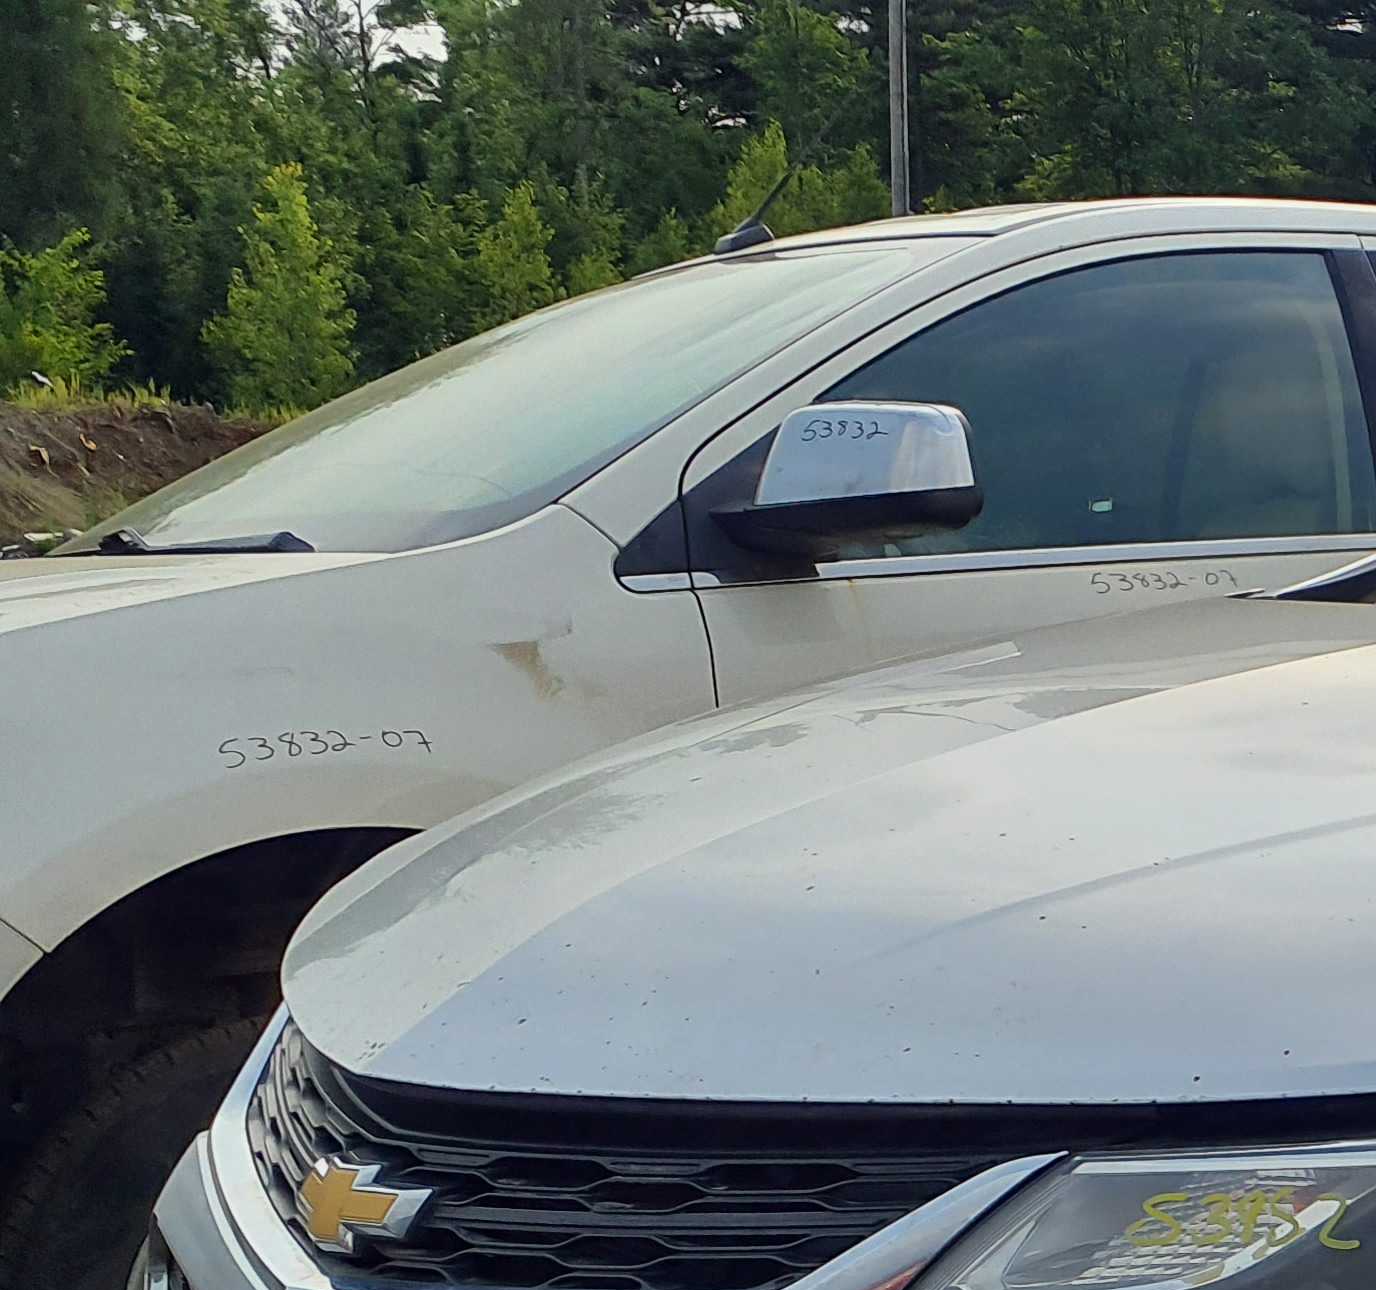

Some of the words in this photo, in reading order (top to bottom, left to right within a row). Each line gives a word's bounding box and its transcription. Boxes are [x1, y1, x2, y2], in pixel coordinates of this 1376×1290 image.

[801, 418, 889, 442] 53832
[1090, 569, 1239, 595] 53832-07
[218, 729, 433, 769] 53832-07
